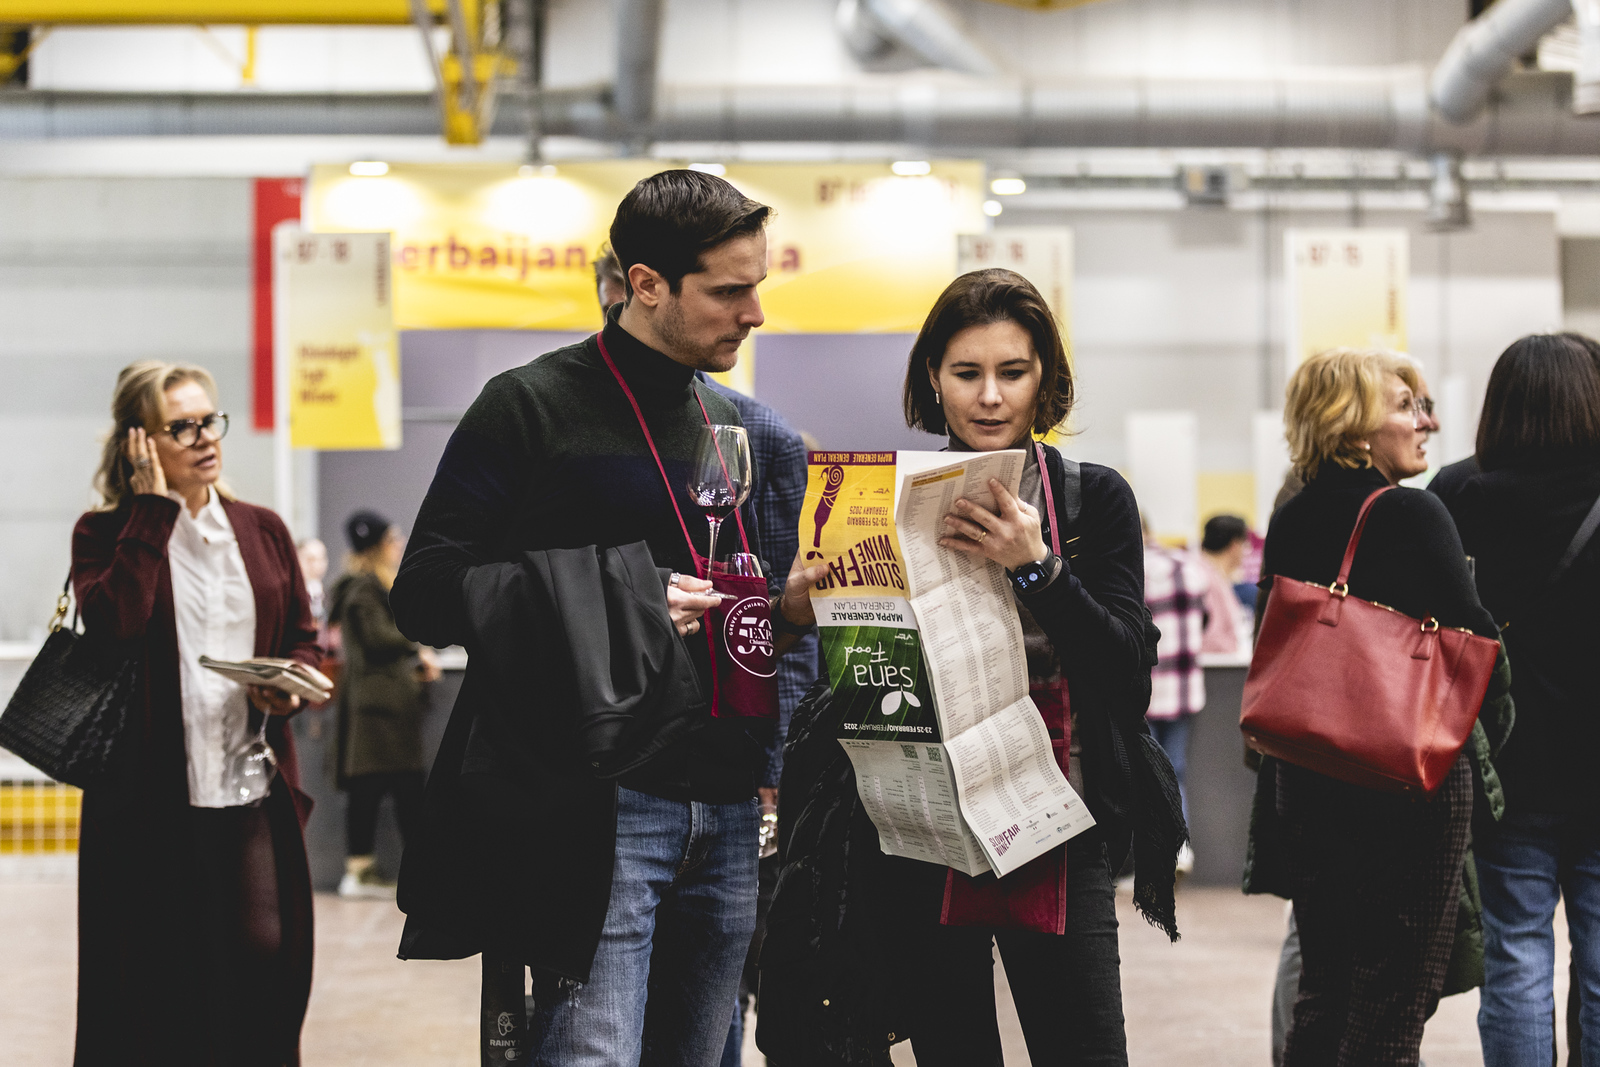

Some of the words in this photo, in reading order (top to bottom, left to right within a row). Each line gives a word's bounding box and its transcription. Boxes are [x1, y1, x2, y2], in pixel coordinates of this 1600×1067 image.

[399, 236, 586, 280] erbaijan
[814, 453, 826, 462] PLAN
[828, 453, 850, 462] GENERAL
[853, 453, 876, 462] GENERALE
[878, 453, 893, 462] MAPPA
[850, 506, 862, 515] 2025
[863, 506, 888, 516] FEBRUARY
[847, 516, 872, 526] FEBBRAIO
[872, 516, 888, 526] 23-25
[856, 534, 896, 563] WINE
[862, 563, 904, 590] SLOW
[834, 602, 856, 610] PLAN
[832, 612, 875, 621] GENERALE
[877, 612, 904, 622] MAPPA
[729, 616, 737, 636] GREVE
[844, 642, 888, 665] Food
[853, 665, 913, 687] sana
[1002, 824, 1021, 845] FAIR
[989, 834, 1005, 847] SLOW
[994, 843, 1009, 857] WINE
